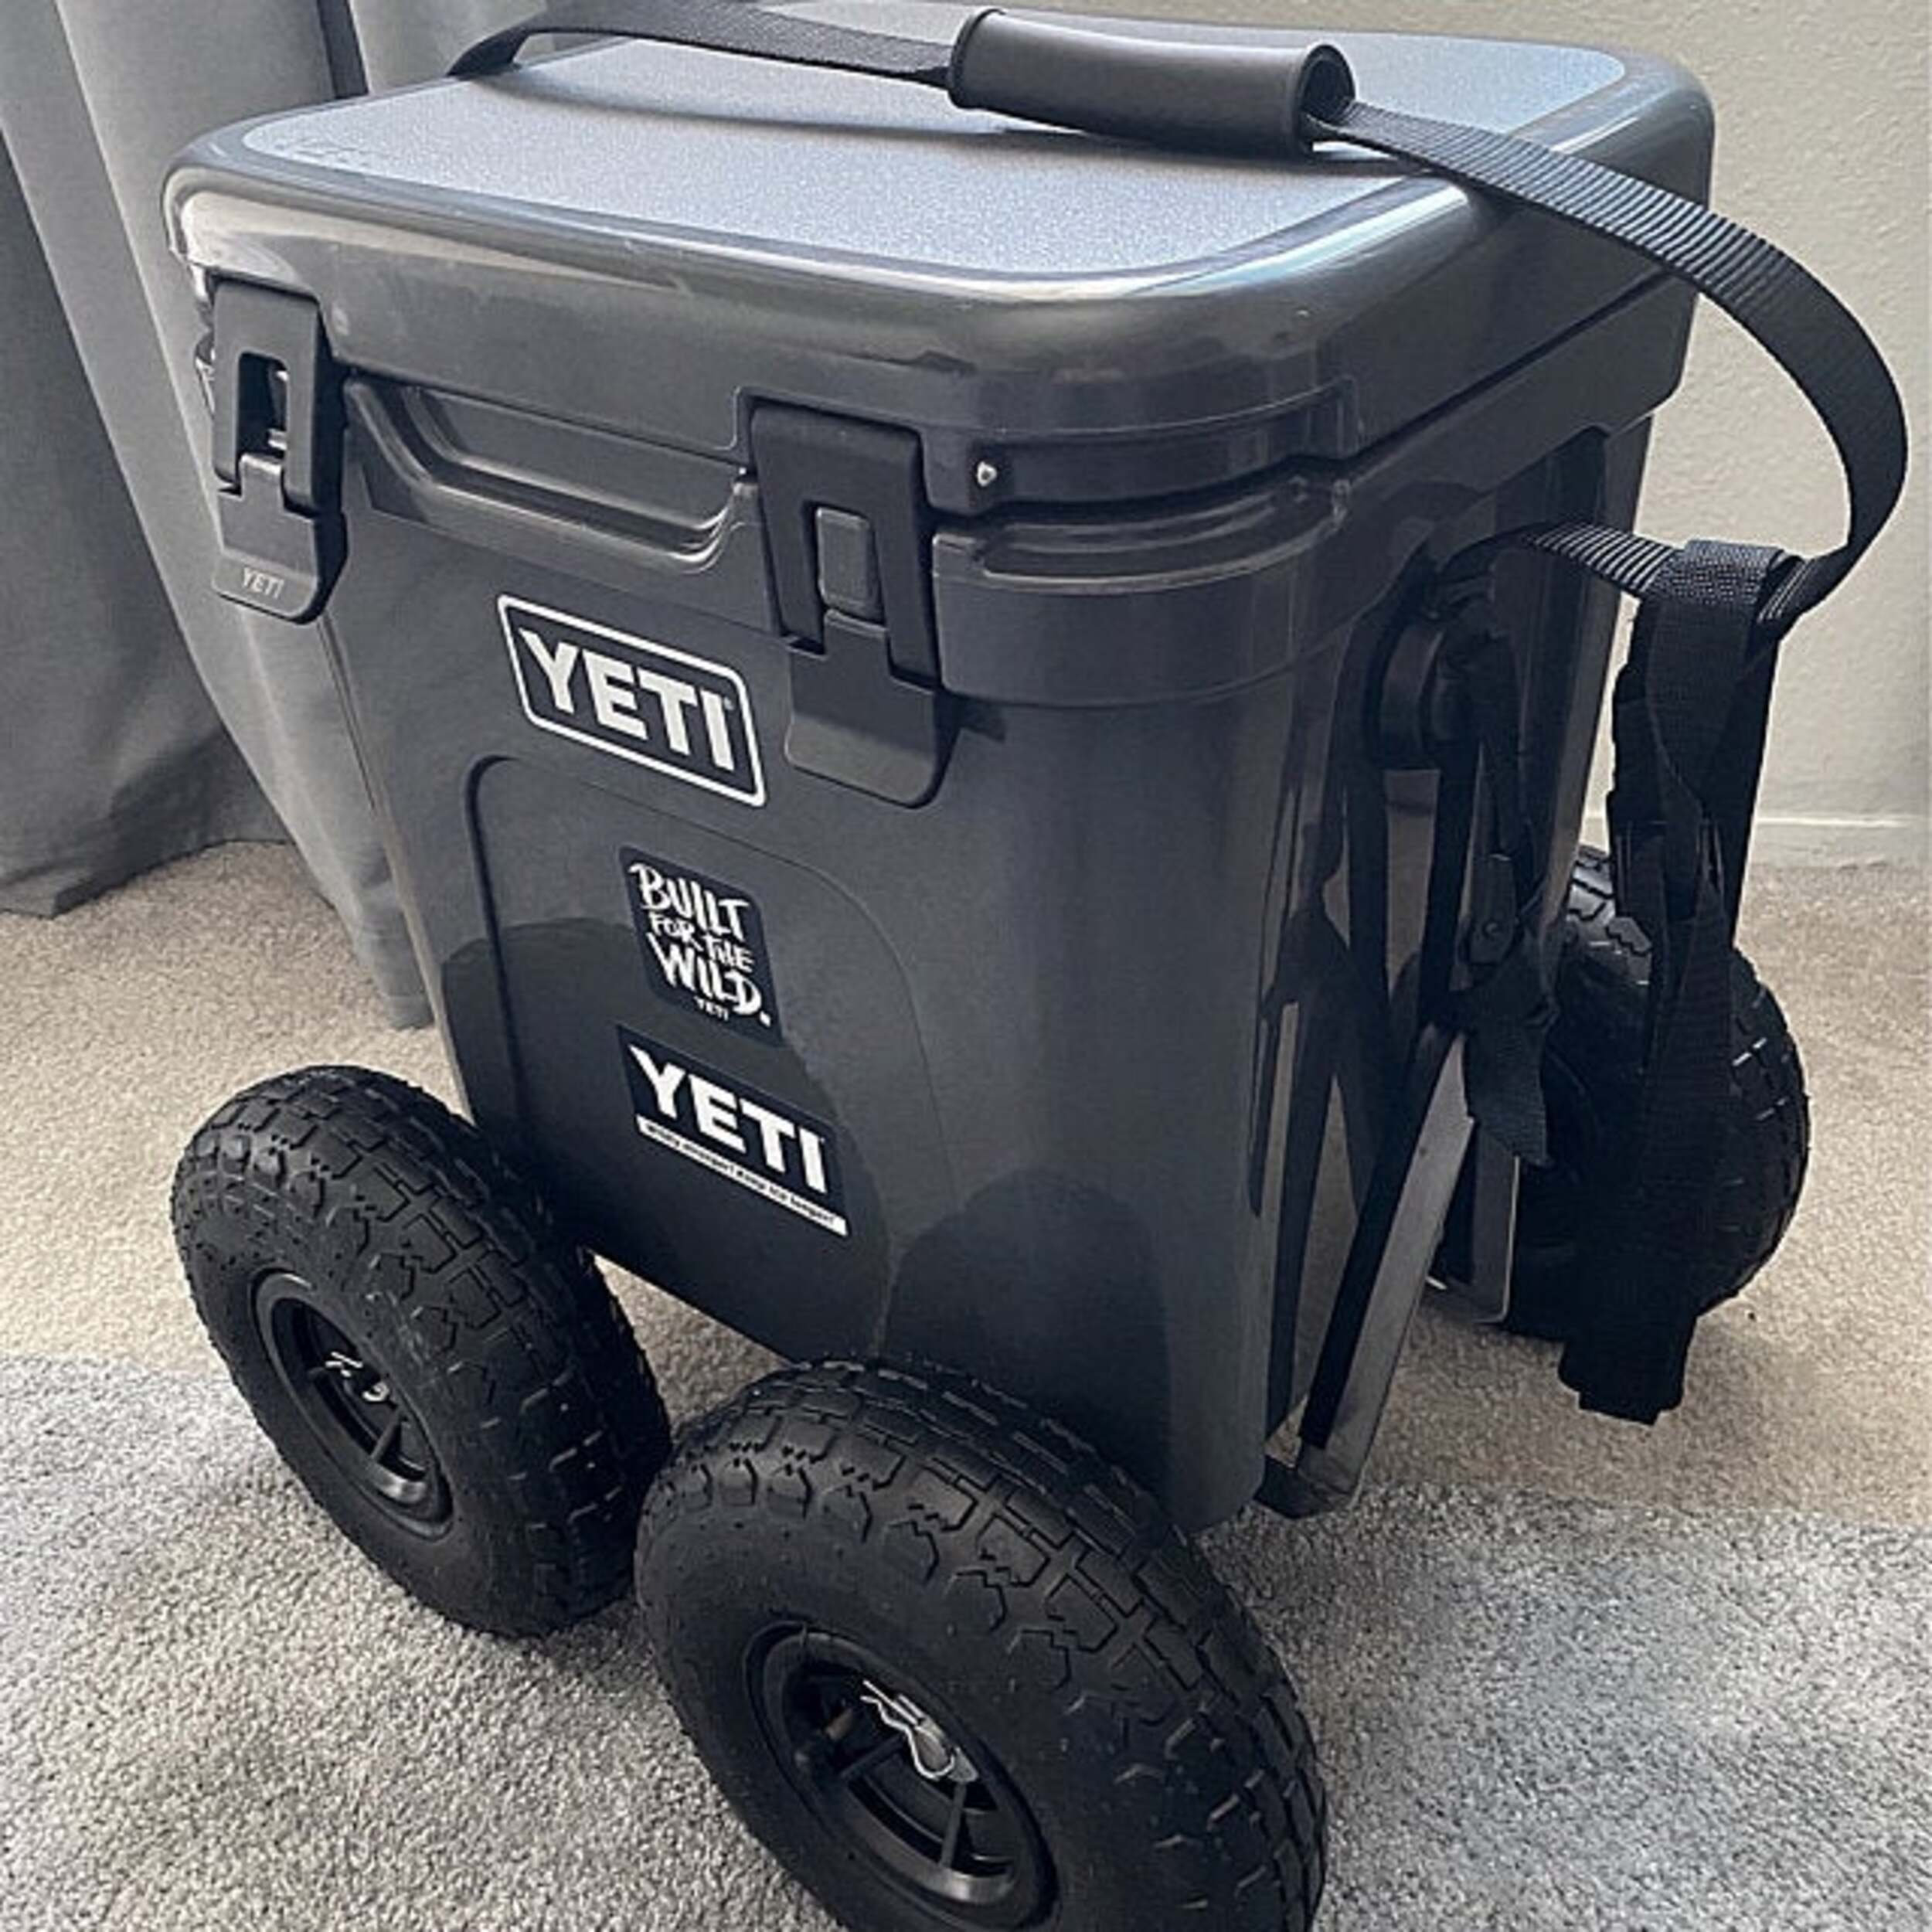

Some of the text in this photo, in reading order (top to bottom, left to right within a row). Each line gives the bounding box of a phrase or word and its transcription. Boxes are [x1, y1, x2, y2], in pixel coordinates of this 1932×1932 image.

[243, 567, 284, 599] YETI
[518, 628, 734, 771] YETI
[628, 863, 750, 942] BUILT
[648, 912, 703, 952] FOR
[628, 1044, 827, 1195] YETI
